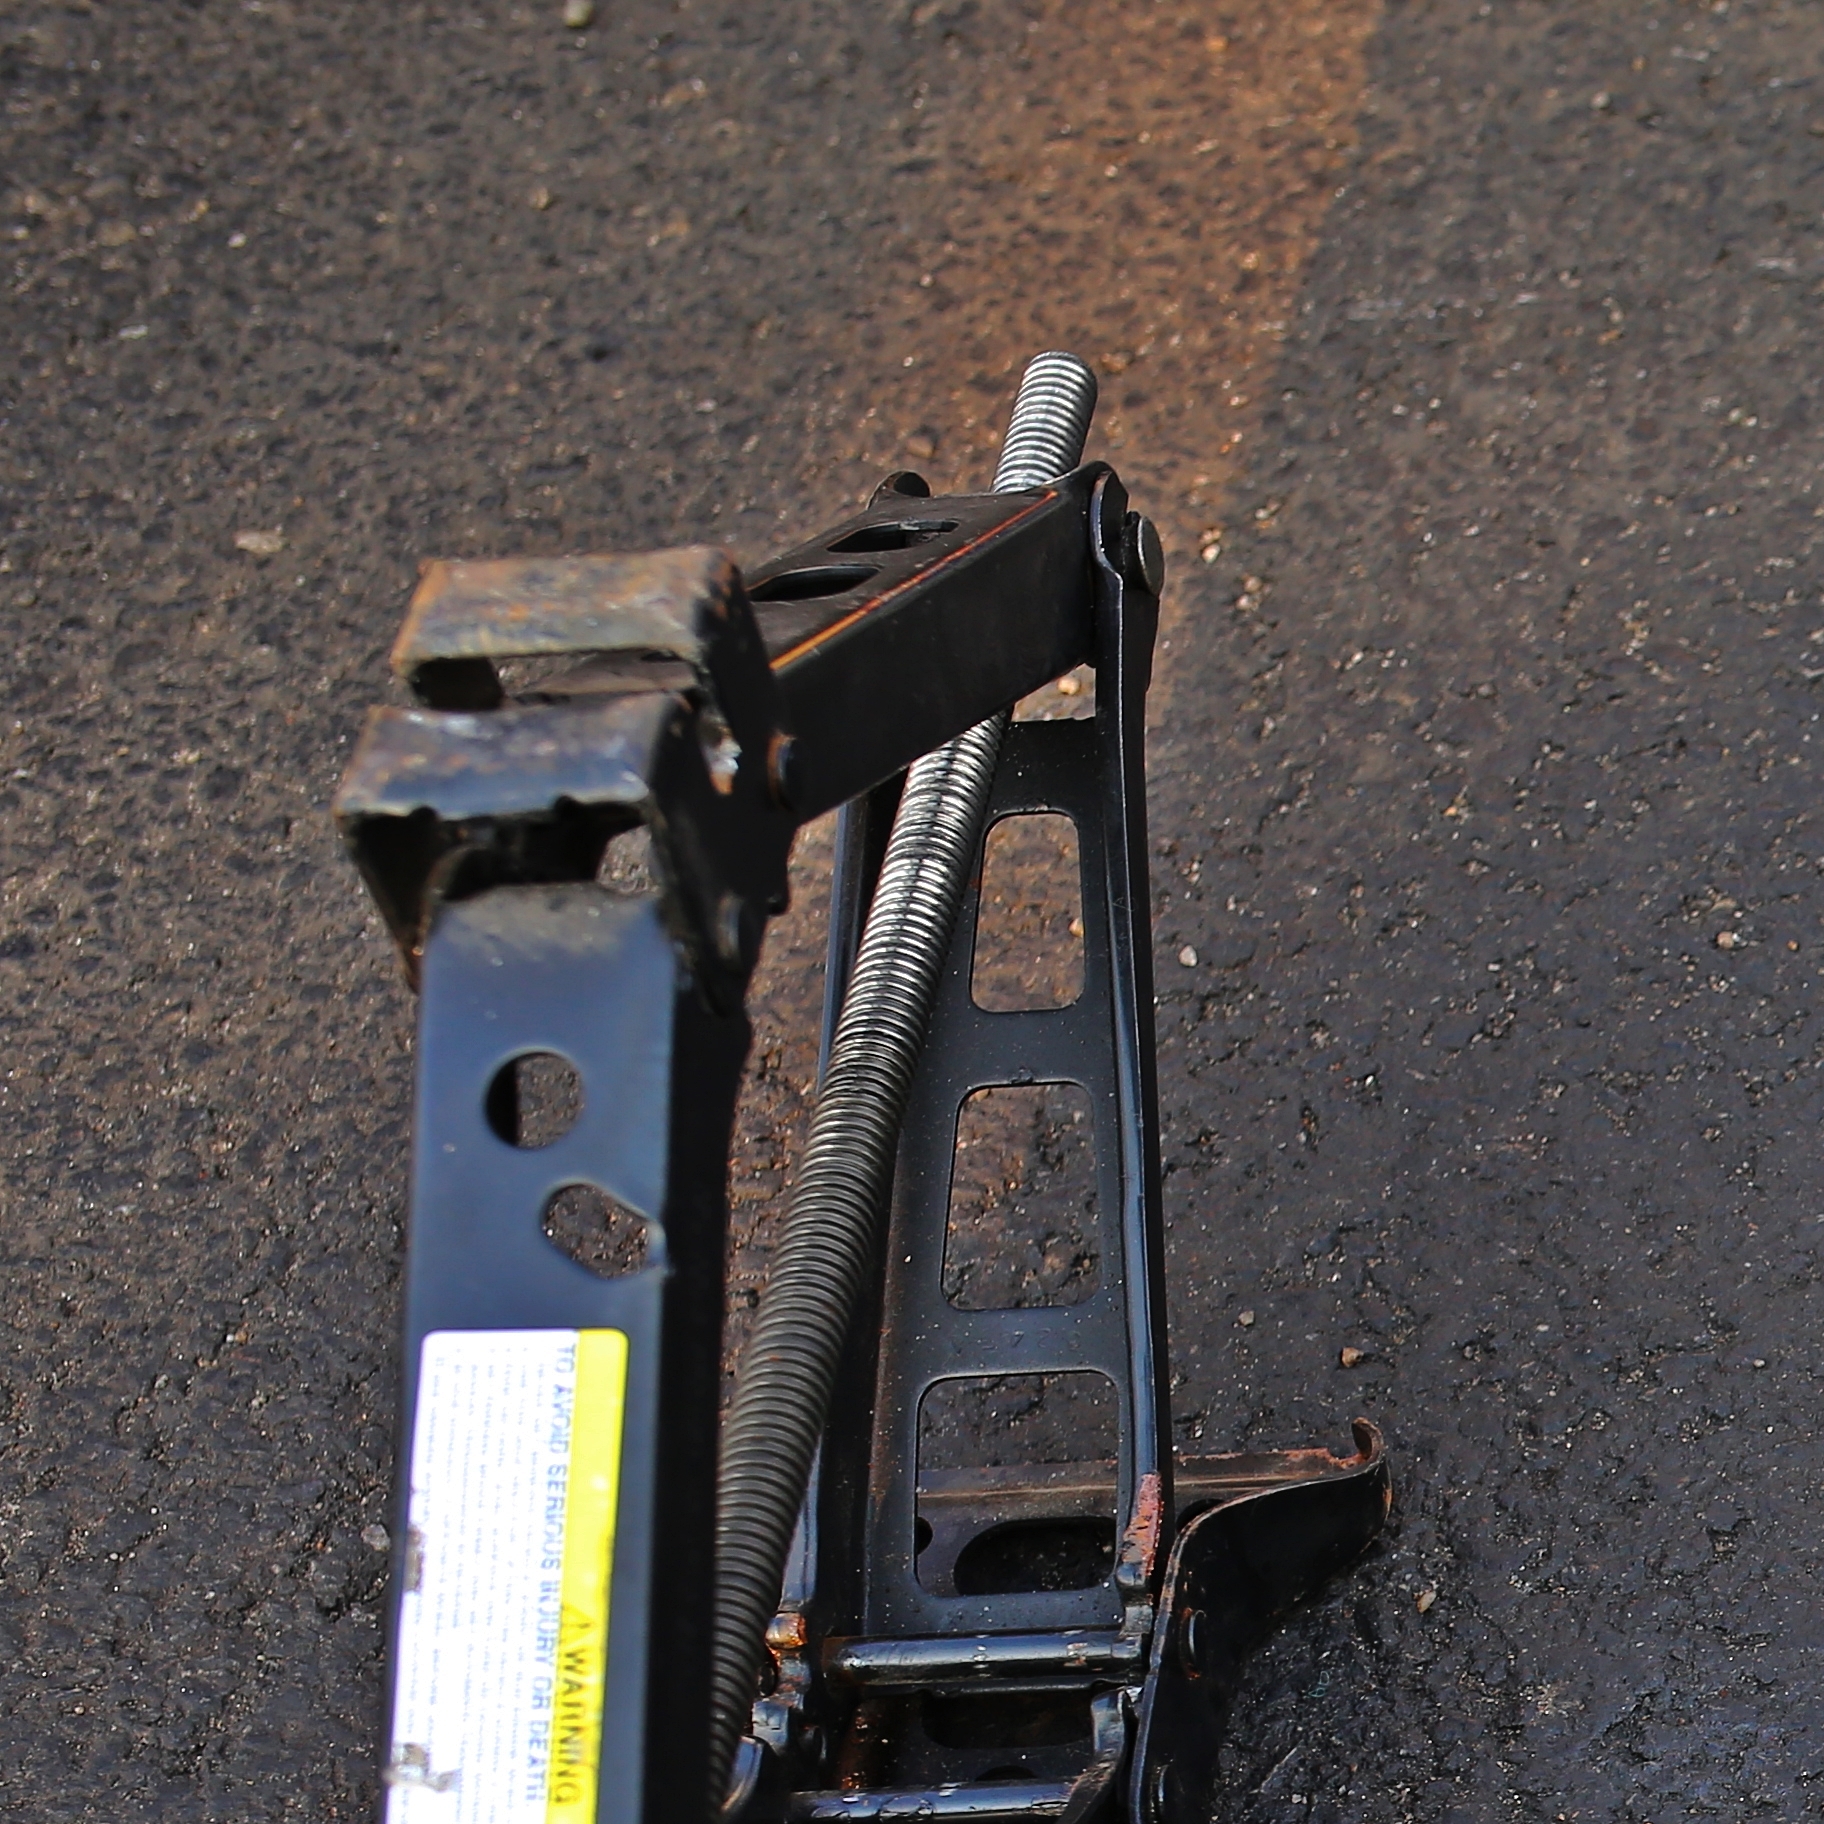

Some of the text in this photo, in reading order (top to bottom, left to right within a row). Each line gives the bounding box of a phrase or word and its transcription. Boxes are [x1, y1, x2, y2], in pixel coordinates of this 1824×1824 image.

[554, 1343, 577, 1375] TO
[540, 1463, 569, 1571] SERIOUS
[530, 1676, 553, 1710] OR
[549, 1647, 590, 1807] WARNING
